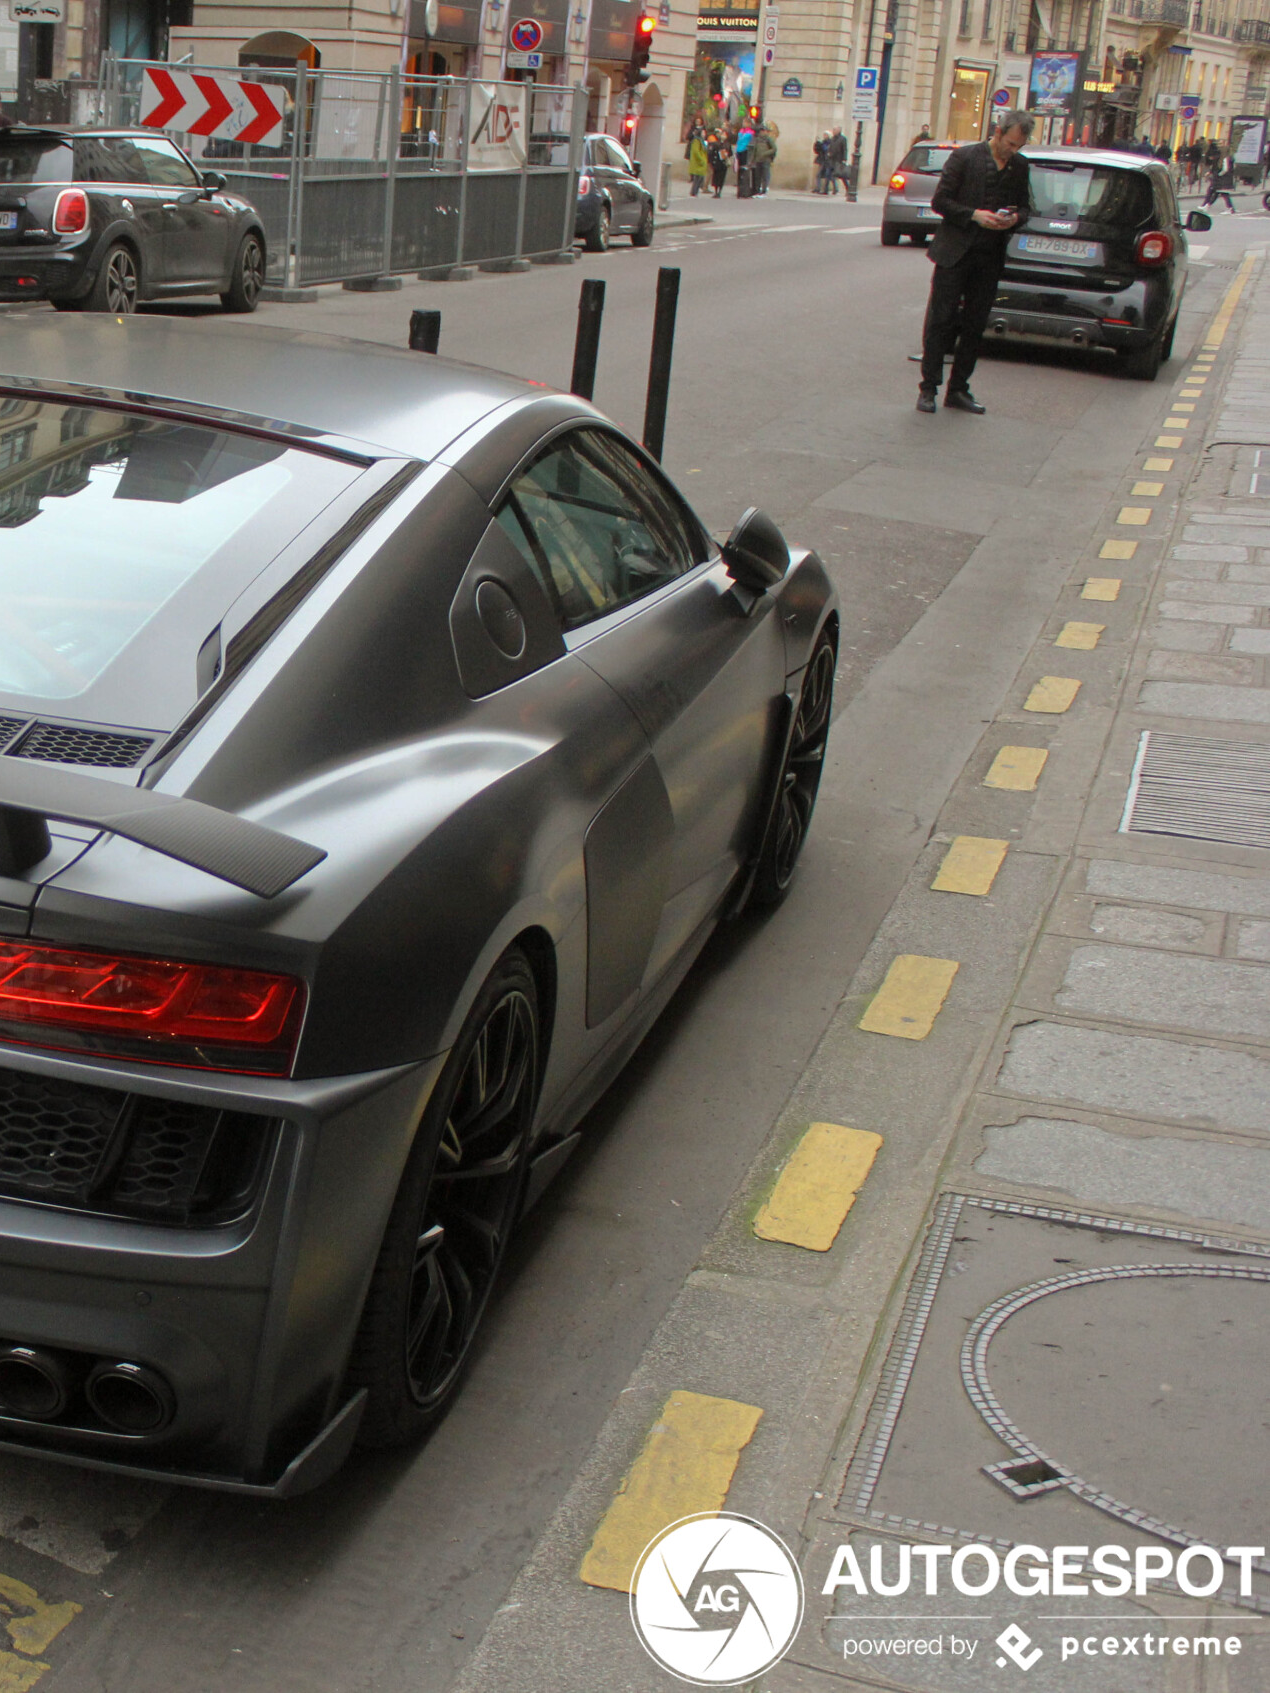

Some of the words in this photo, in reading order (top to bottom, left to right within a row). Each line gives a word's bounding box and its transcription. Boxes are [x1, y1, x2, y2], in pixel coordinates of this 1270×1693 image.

[720, 17, 758, 27] VUITTON
[860, 72, 872, 86] P
[1049, 222, 1072, 230] smart
[1026, 236, 1088, 255] EH-789-DX
